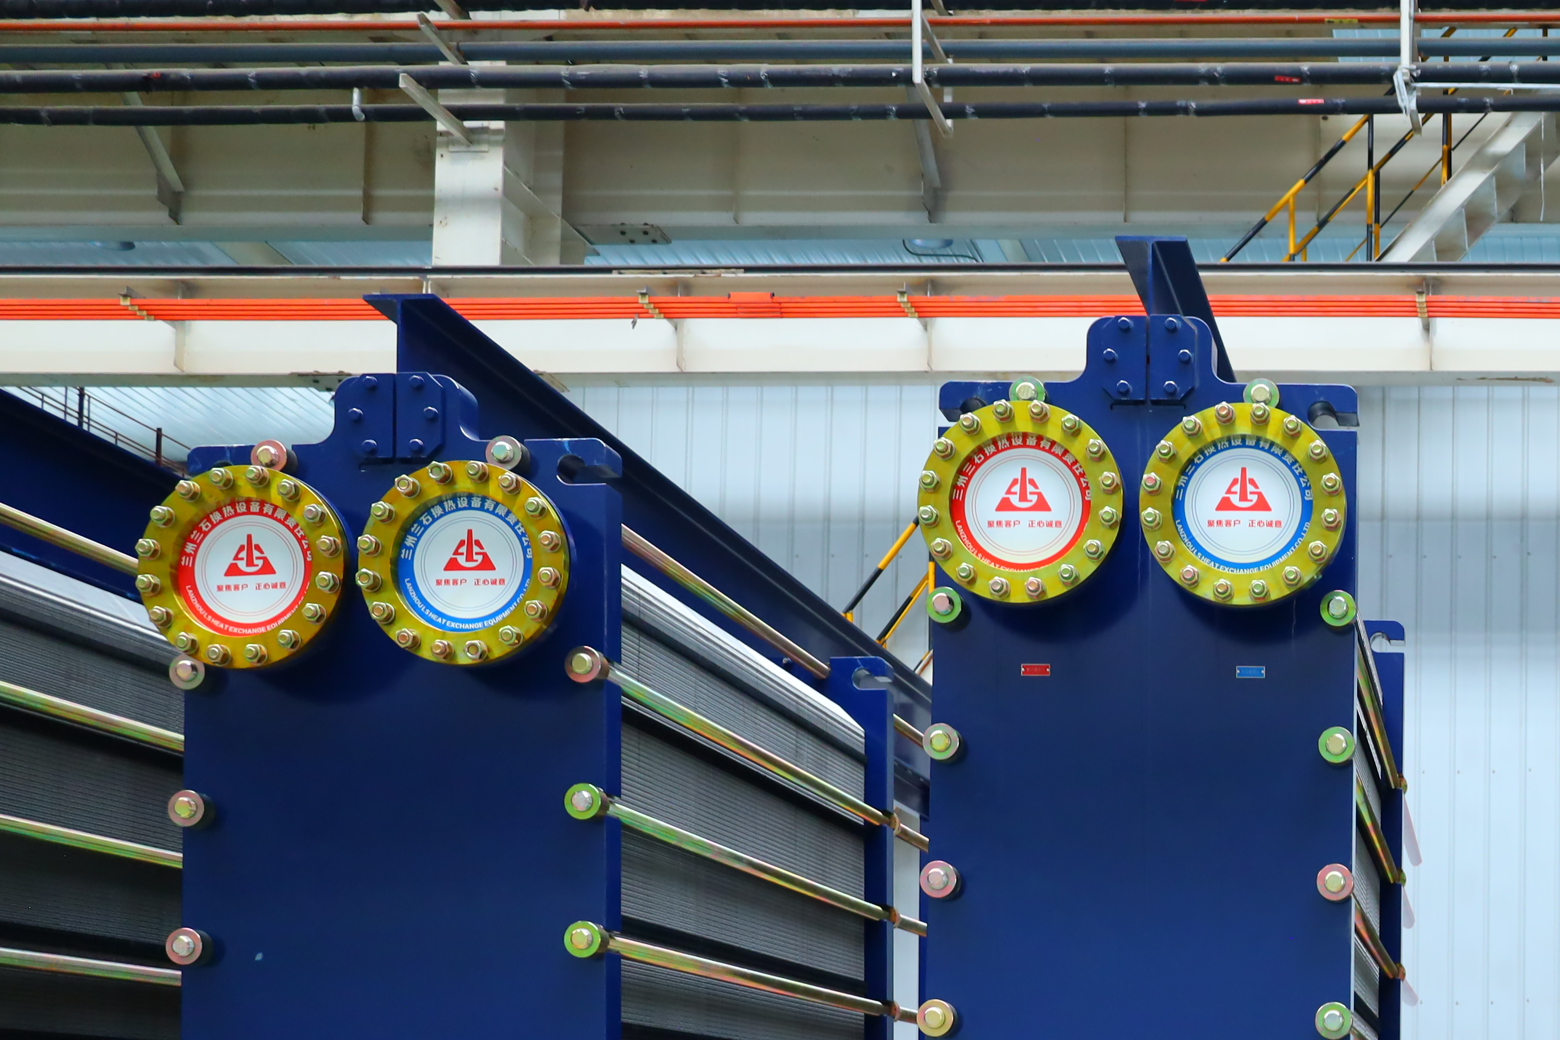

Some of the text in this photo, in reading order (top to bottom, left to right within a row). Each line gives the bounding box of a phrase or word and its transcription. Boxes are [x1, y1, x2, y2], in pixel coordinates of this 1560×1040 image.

[954, 519, 975, 552] LANZHOU
[987, 520, 1062, 528] 聚焦客户 正心诚意
[1248, 520, 1282, 528] 正心诚意
[1174, 518, 1195, 551] LANZHOU
[1200, 555, 1220, 569] HEAT
[1219, 564, 1258, 573] EXCHANGE
[216, 582, 287, 592] 聚焦客户 正心诚意
[404, 577, 424, 608] LANZHOU
[428, 611, 447, 625] HEAT
[446, 619, 483, 629] EXCHANGE
[185, 584, 206, 615] LANZHOU
[210, 617, 229, 630] HEAT
[228, 624, 265, 634] EXCHANGE
